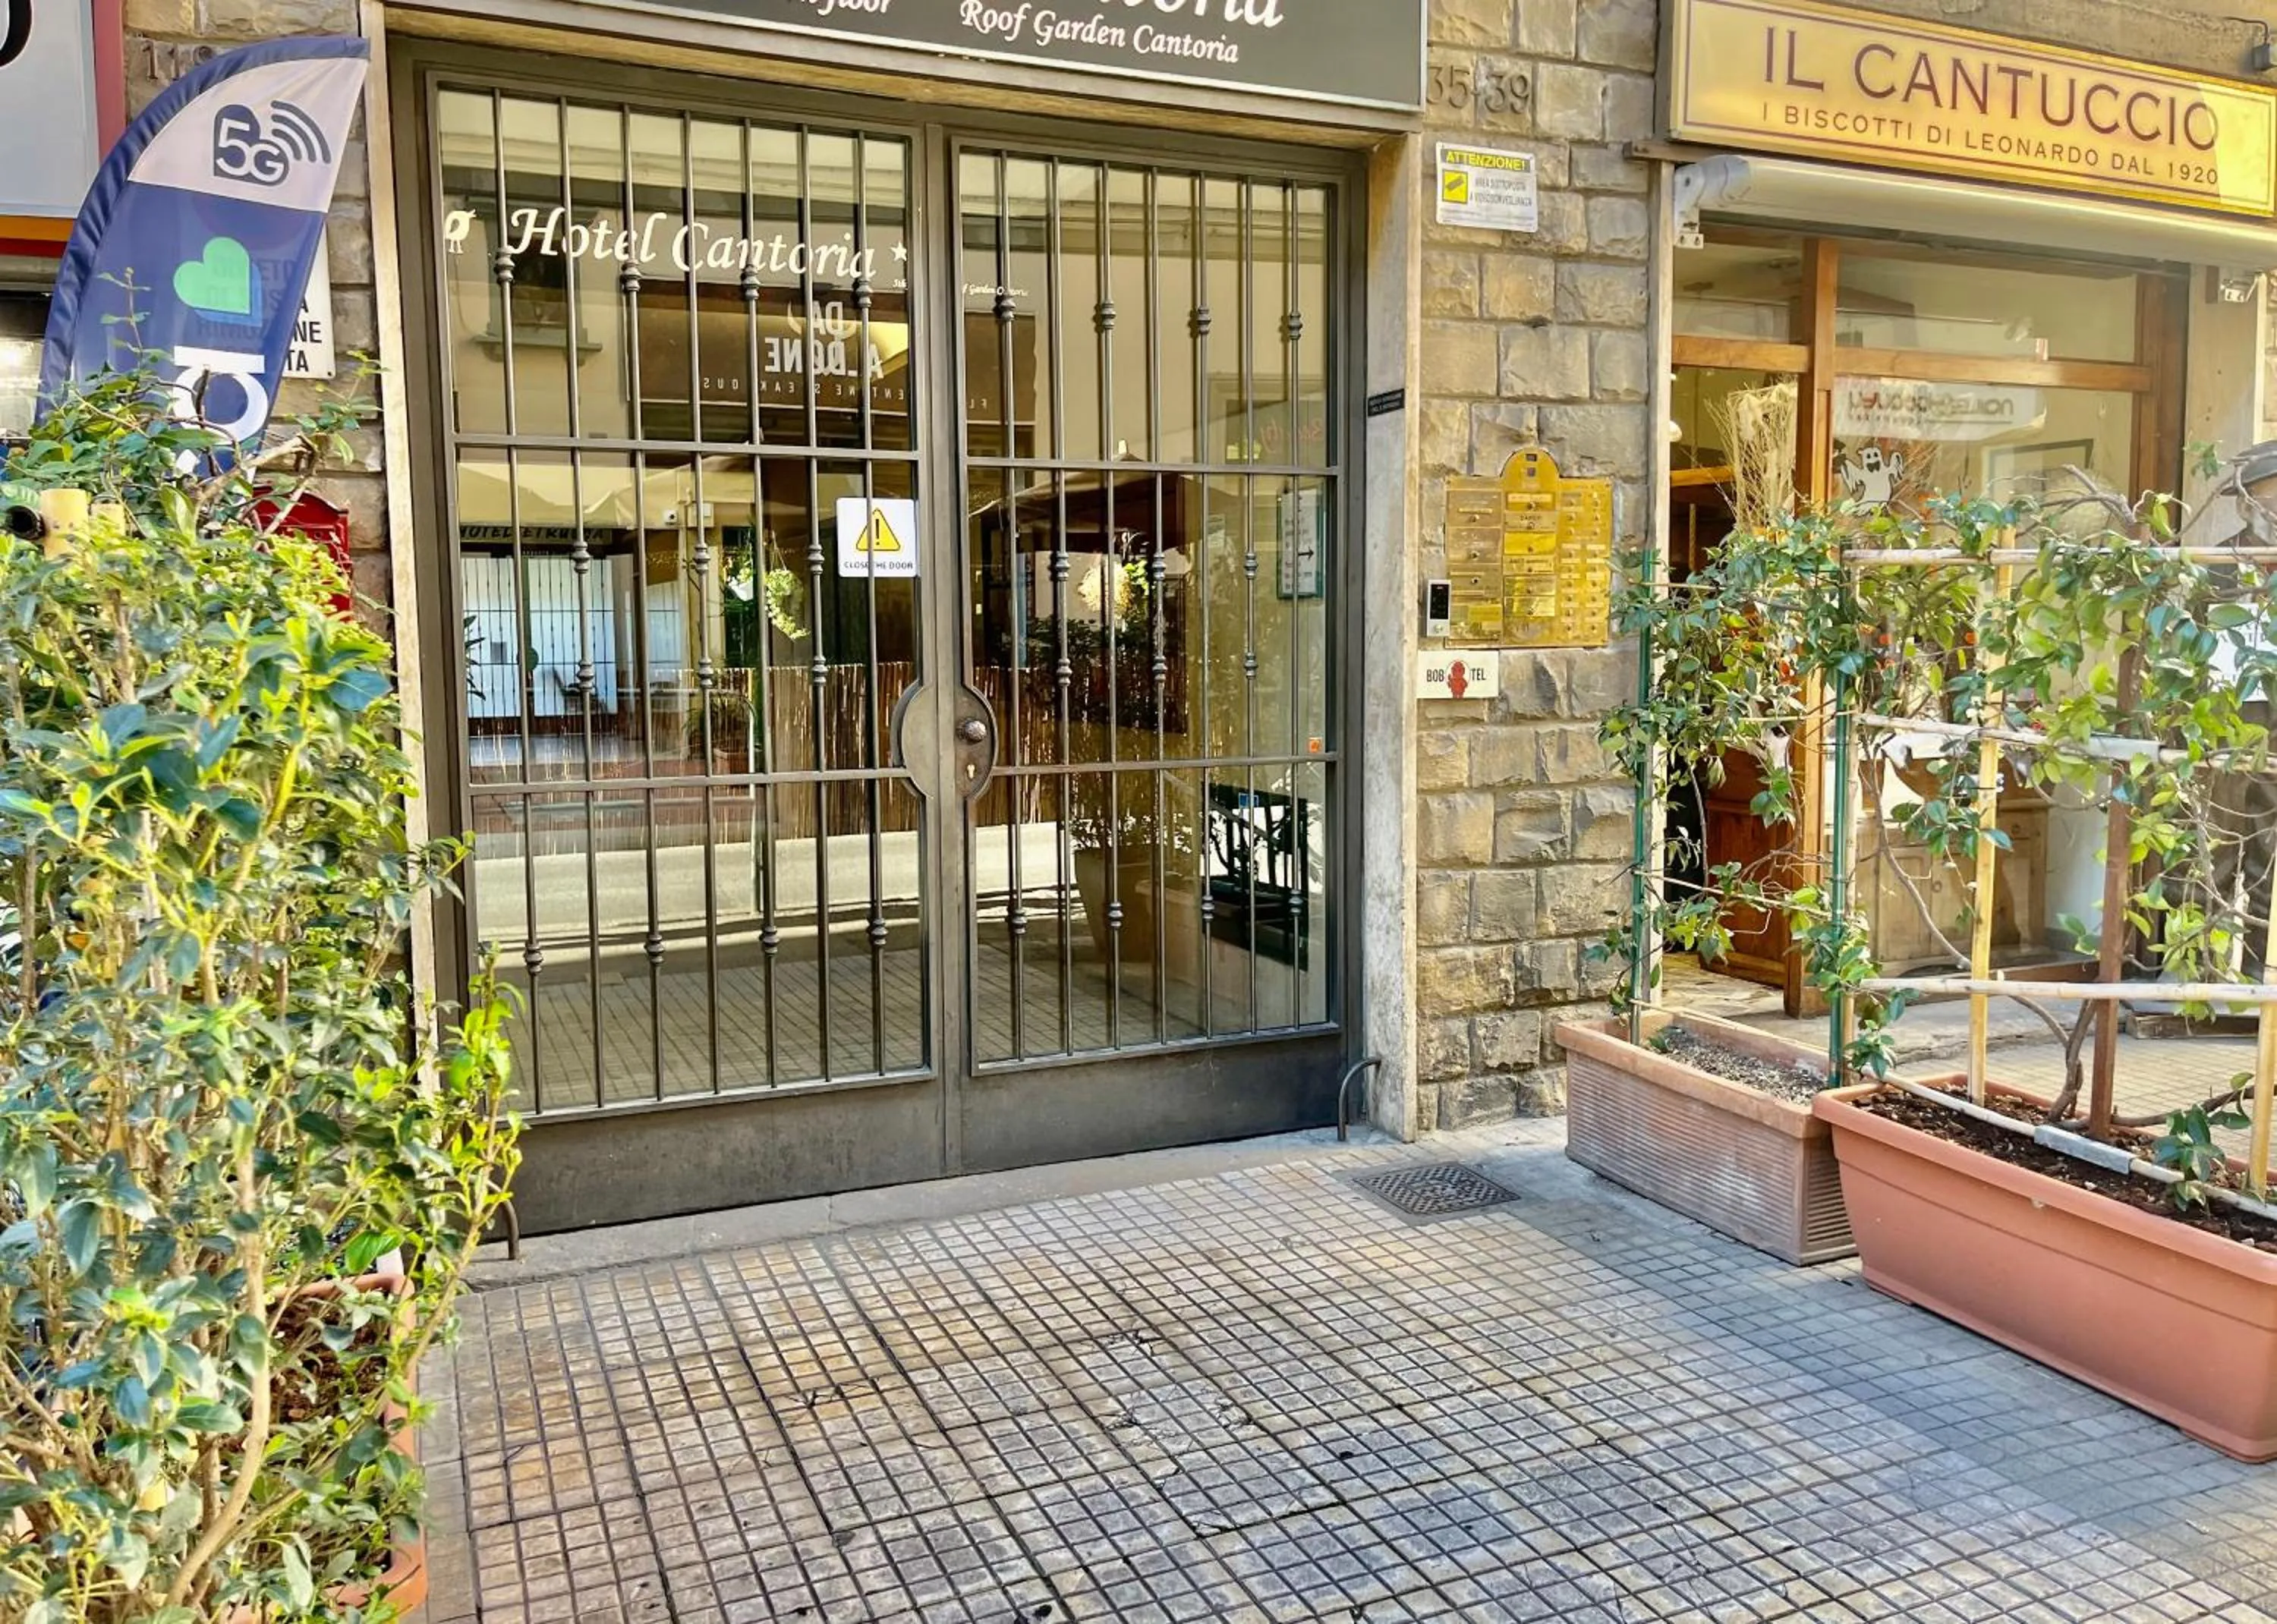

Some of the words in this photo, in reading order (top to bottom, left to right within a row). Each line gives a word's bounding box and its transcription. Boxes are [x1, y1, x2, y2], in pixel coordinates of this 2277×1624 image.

[960, 1, 1031, 42] Roof
[1033, 10, 1126, 47] Garden
[1133, 24, 1239, 63] Cantoria
[1764, 27, 1825, 92] IL
[1854, 43, 2219, 150] CANTUCCIO
[216, 118, 285, 183] 5G
[1446, 150, 1525, 171] ATTENZIONE!
[1762, 102, 1768, 121] I
[1784, 105, 1912, 140] BISCOTTI
[1928, 125, 1951, 146] DI
[1965, 131, 2099, 165] LEONARDO
[2112, 153, 2154, 175] DAL
[2168, 162, 2219, 184] 1920
[504, 206, 667, 263] Hotel
[672, 222, 877, 277] Cantoria
[889, 562, 914, 570] DOOR
[1426, 669, 1444, 682] BOB
[1469, 667, 1487, 681] TEL
